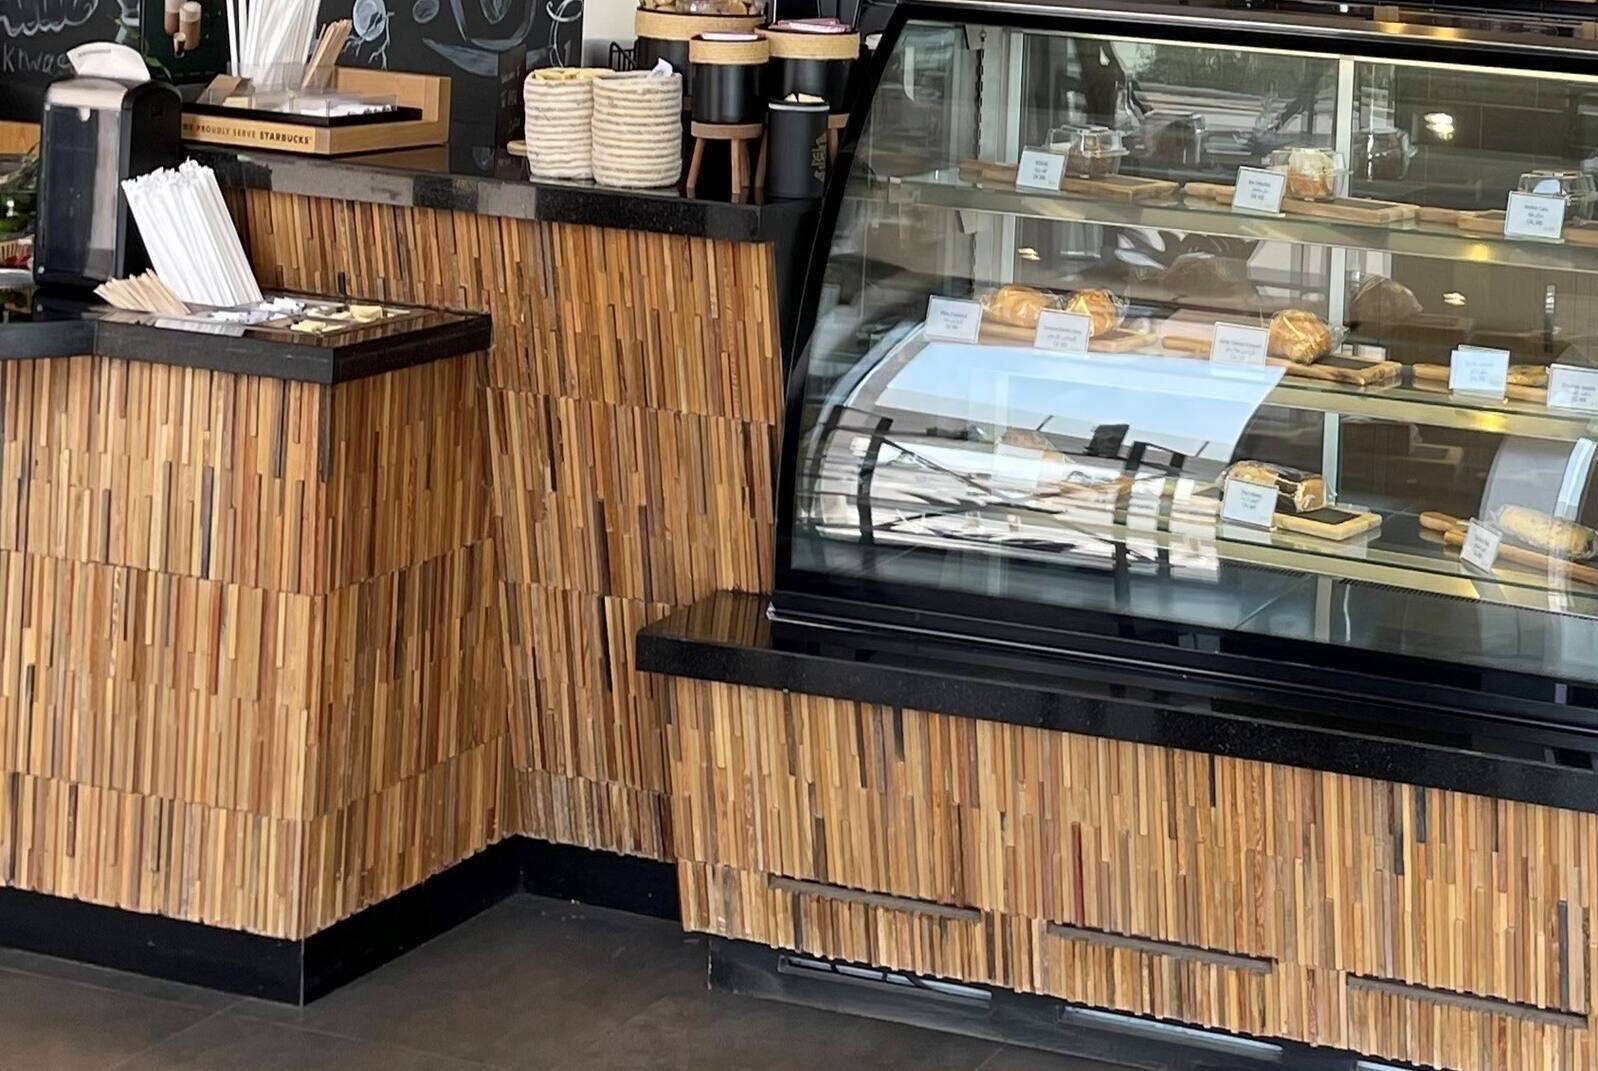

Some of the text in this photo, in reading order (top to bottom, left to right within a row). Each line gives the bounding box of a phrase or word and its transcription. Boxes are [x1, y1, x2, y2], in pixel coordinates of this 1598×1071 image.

[196, 124, 310, 144] PROUDLY SERVE STARBUCKS
